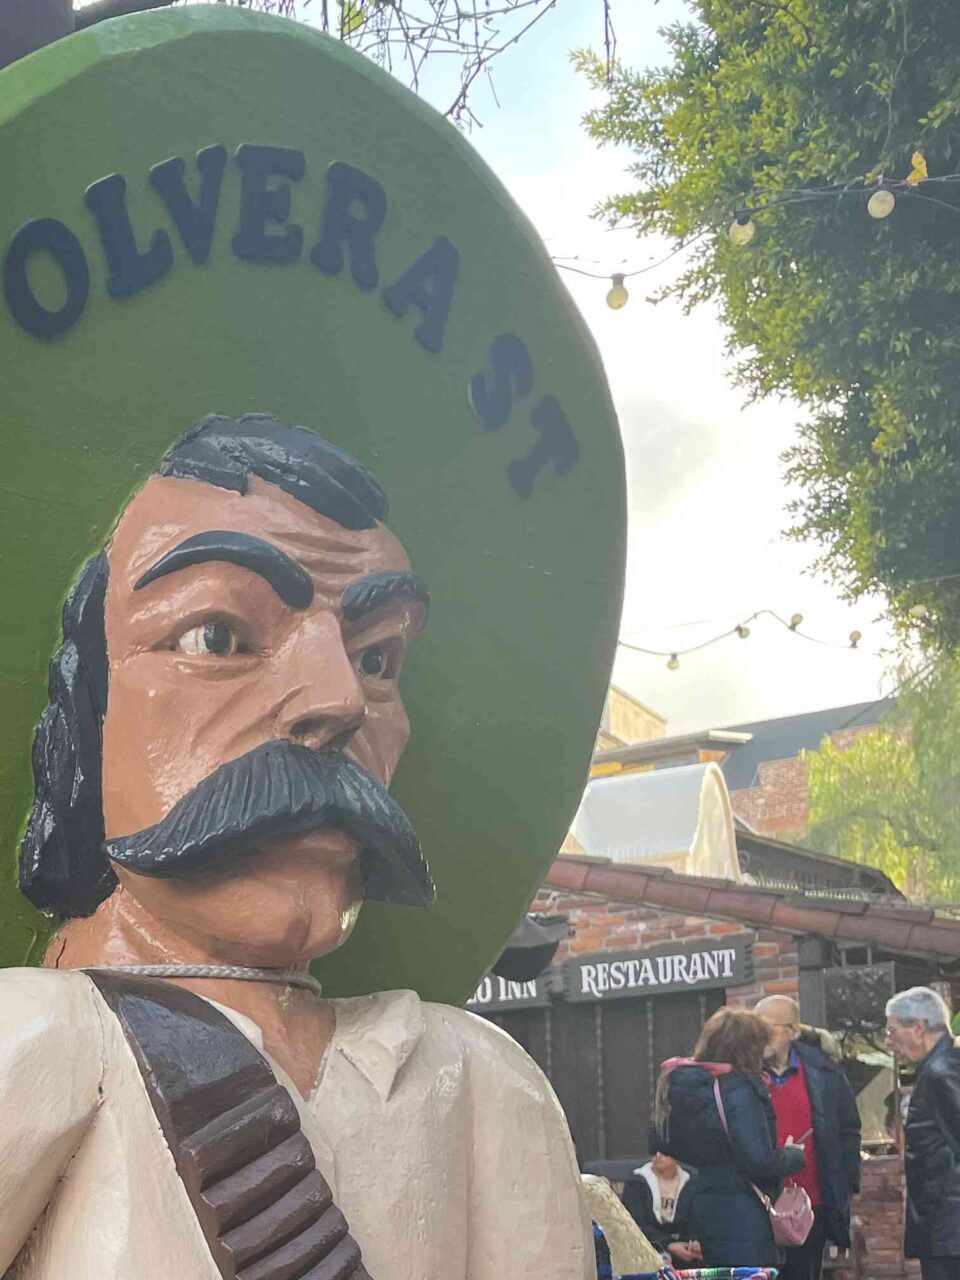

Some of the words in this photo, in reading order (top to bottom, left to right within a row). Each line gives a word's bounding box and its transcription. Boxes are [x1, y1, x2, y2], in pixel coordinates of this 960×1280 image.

[2, 143, 460, 353] OLVERA
[468, 332, 580, 500] ST
[498, 975, 538, 1001] INN
[580, 948, 736, 997] RESTAURANT
